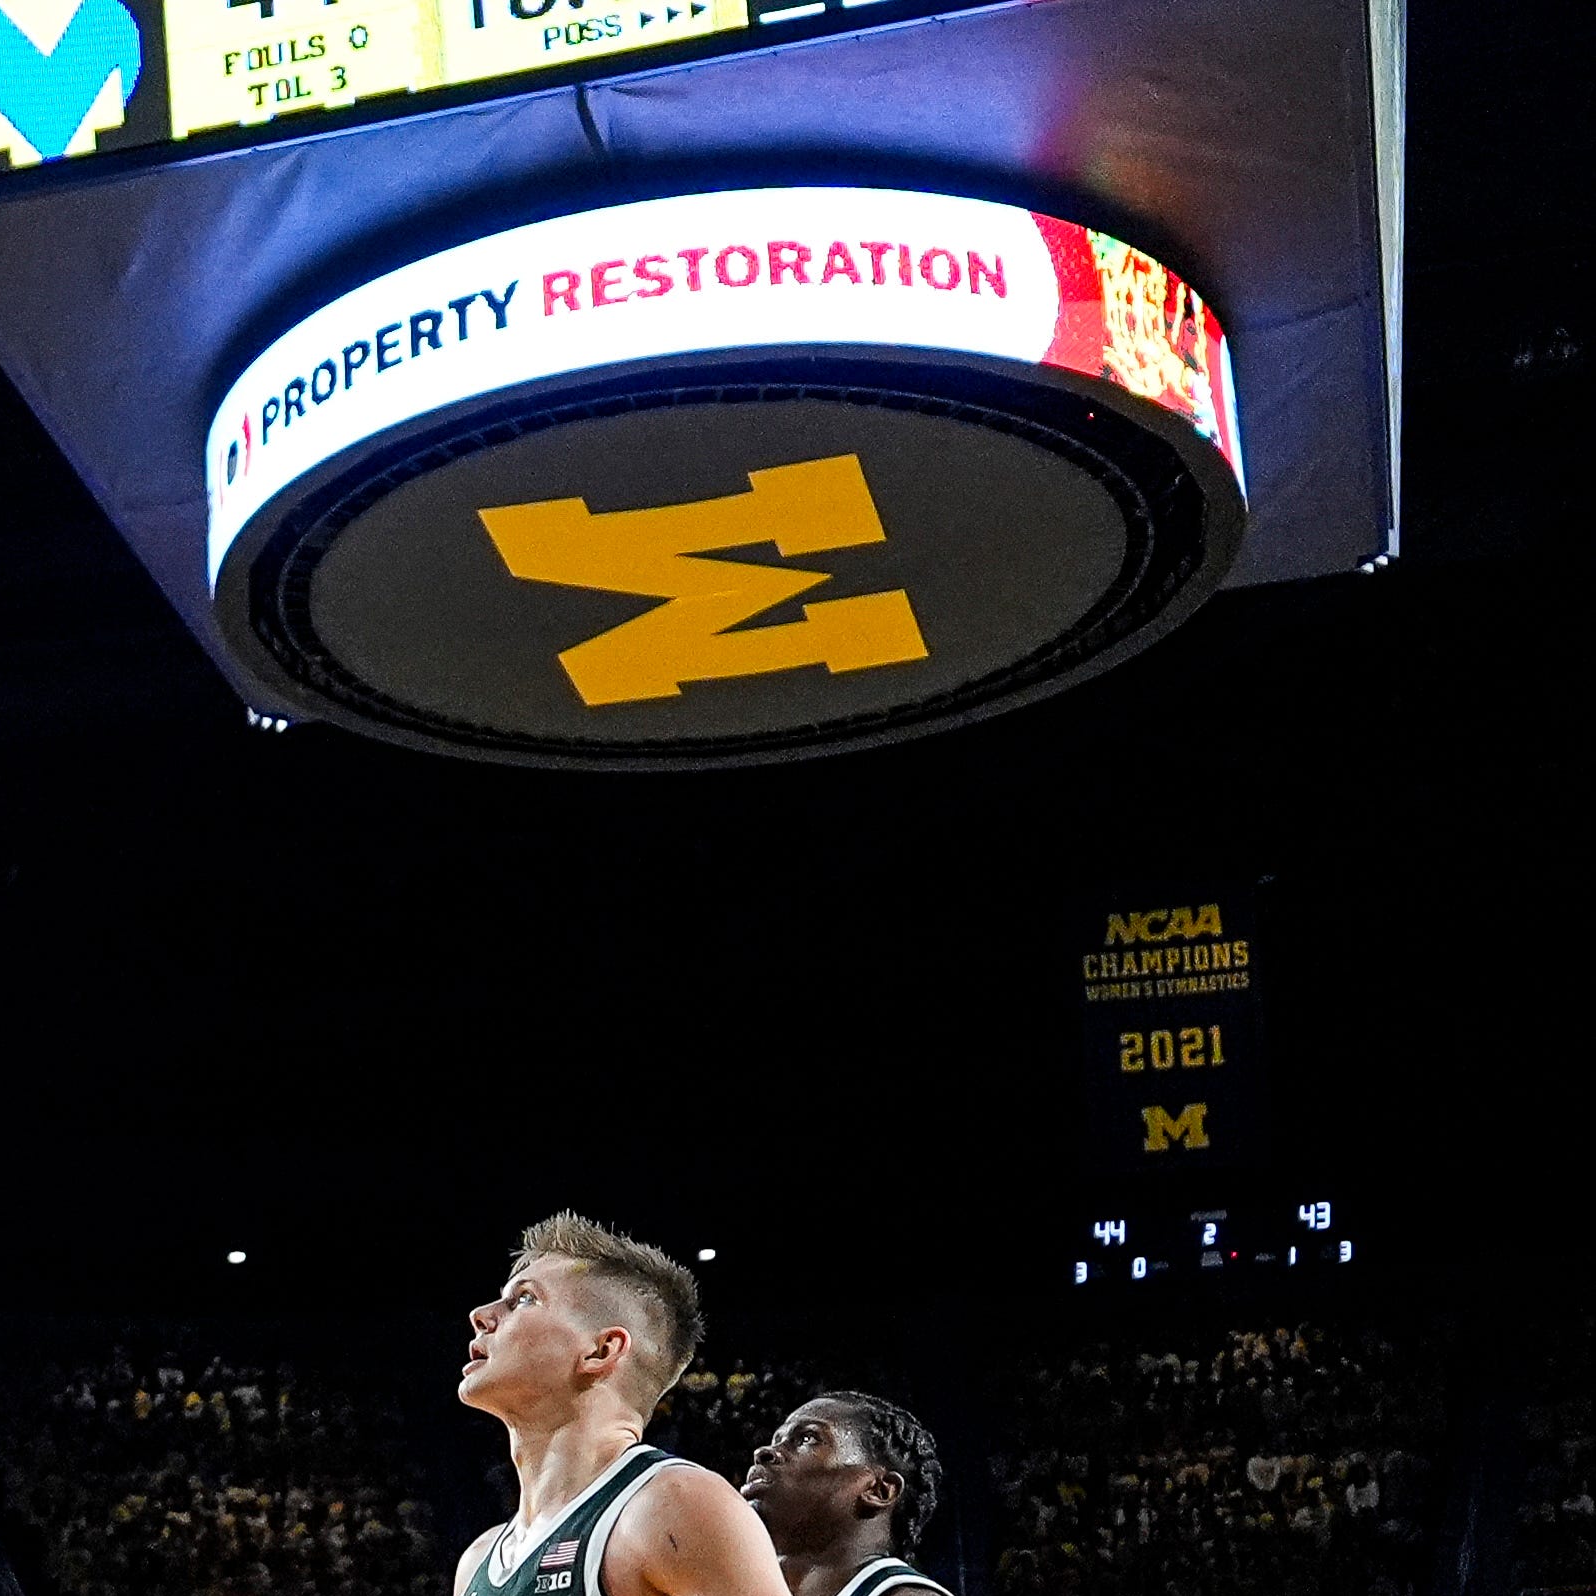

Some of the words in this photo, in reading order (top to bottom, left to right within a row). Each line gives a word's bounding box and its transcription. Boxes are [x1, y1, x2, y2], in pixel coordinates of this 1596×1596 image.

[543, 14, 622, 50] POSS
[224, 34, 326, 75] FOULS
[247, 75, 312, 106] TOL
[329, 65, 347, 91] 3
[259, 278, 521, 445] PROPERTY
[541, 238, 1007, 318] RESTORATION
[477, 450, 930, 707] M
[1105, 903, 1222, 946] NCAA
[1082, 940, 1250, 981] CHAMPIONS
[1119, 1025, 1226, 1073] 2021
[1140, 1102, 1210, 1153] M
[1093, 1219, 1126, 1246] 44
[1298, 1201, 1331, 1230] 43
[1202, 1222, 1217, 1246] 2
[1073, 1260, 1088, 1284] 3
[1131, 1256, 1147, 1280] 0
[1338, 1239, 1352, 1264] 3
